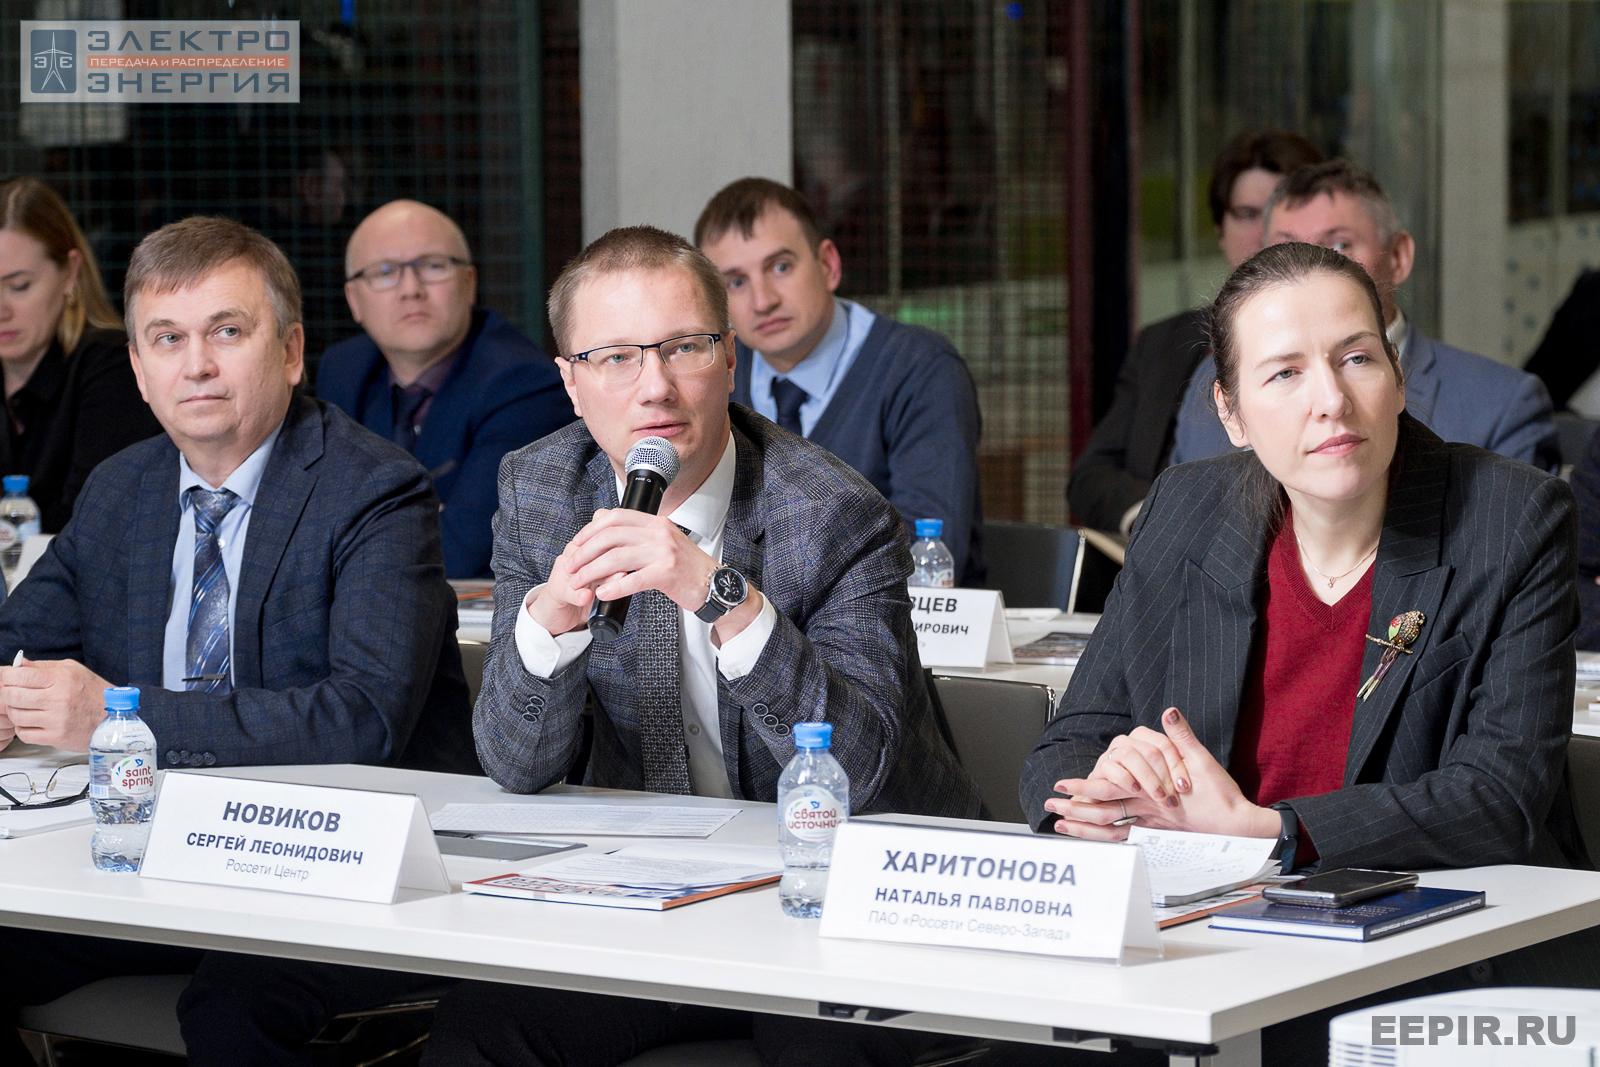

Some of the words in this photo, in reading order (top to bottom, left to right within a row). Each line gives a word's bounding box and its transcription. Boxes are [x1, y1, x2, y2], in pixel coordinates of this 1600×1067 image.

[914, 622, 969, 635] ИРОВИЧ
[122, 774, 154, 789] spring
[125, 766, 151, 777] saint
[222, 801, 342, 832] НОВИКОВ
[789, 819, 841, 829] источни
[794, 808, 837, 819] святой
[186, 832, 246, 852] СЕРГЕЙ
[249, 839, 364, 865] ЛЕОНИДОВИЧ
[225, 858, 271, 877] Россети
[274, 865, 309, 881] Центр
[882, 850, 1077, 886] ХАРИТОНОВА
[875, 887, 961, 908] НАТАЛЬЯ
[967, 895, 1074, 918] ПАВЛОВНА
[868, 910, 899, 925] ПАО
[902, 913, 964, 930] «Россети
[967, 918, 1071, 941] Северо-Запад»
